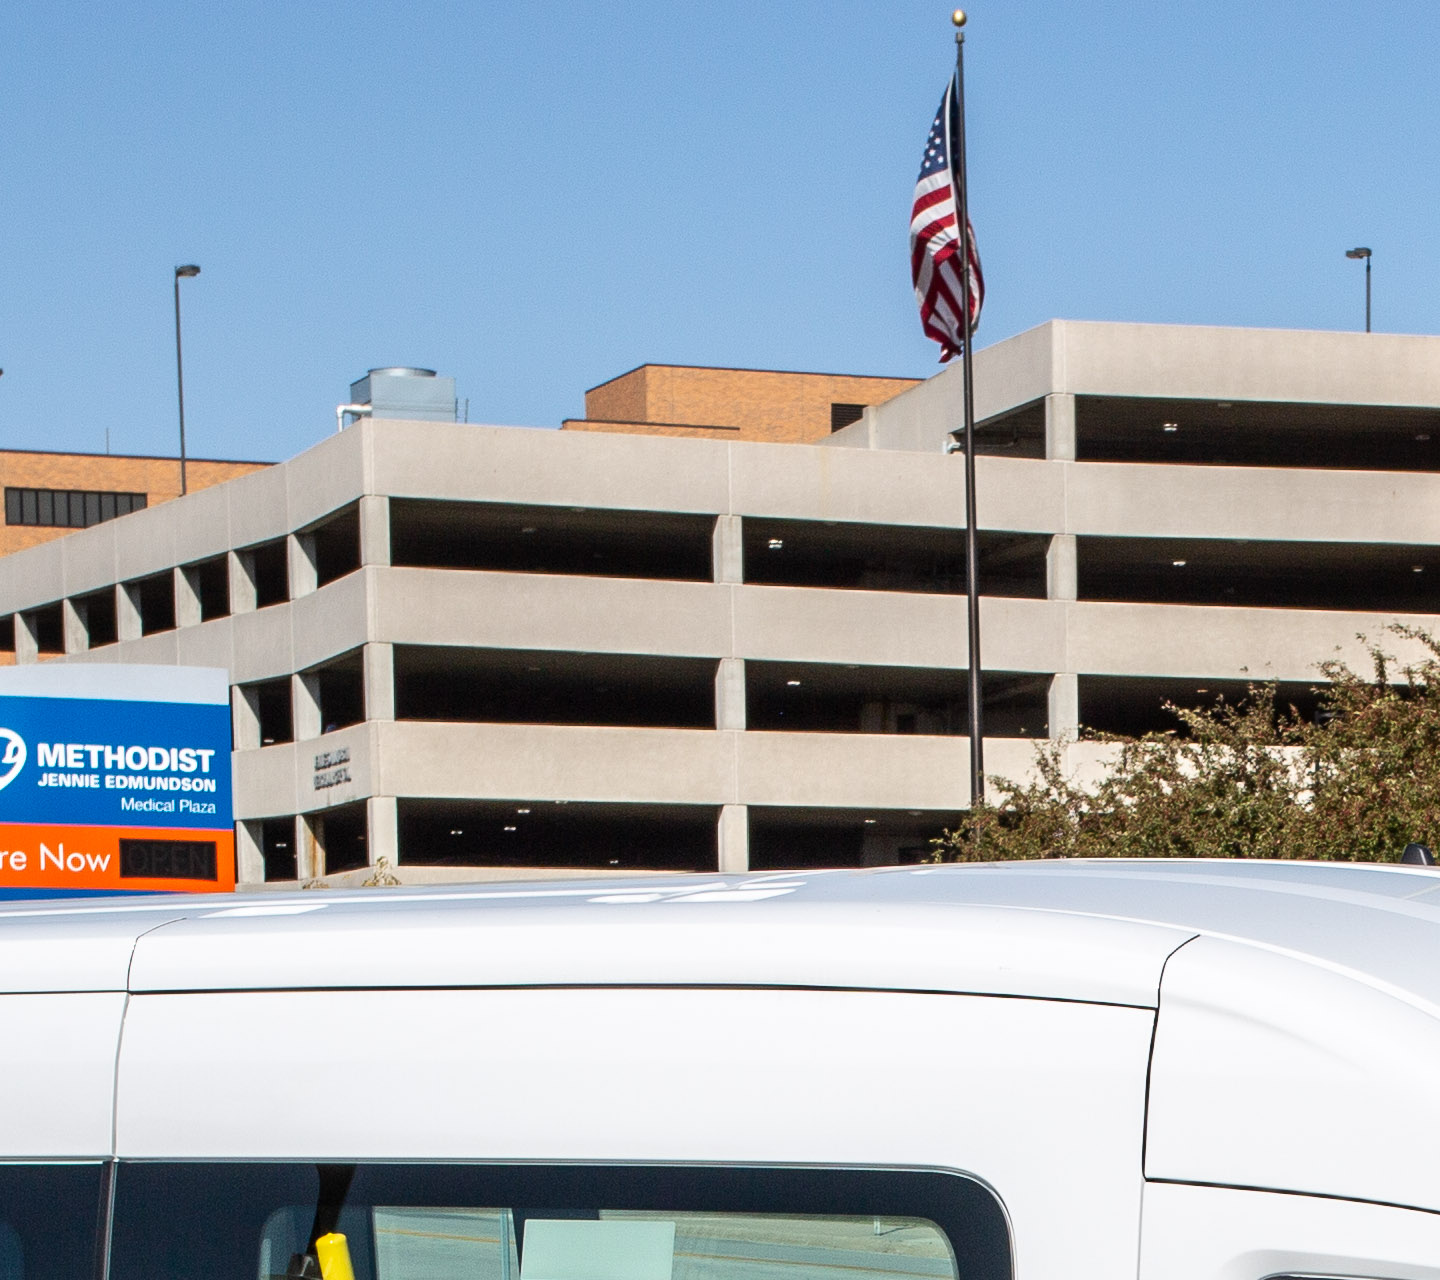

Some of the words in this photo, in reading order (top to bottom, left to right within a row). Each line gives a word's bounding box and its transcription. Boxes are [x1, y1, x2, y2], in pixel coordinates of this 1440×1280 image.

[37, 742, 216, 773] METHODIST
[37, 772, 101, 788] JENNIE
[105, 774, 216, 793] EDMUNDSON
[121, 797, 175, 813] Medical
[179, 798, 216, 814] Plaza
[39, 842, 111, 872] Now
